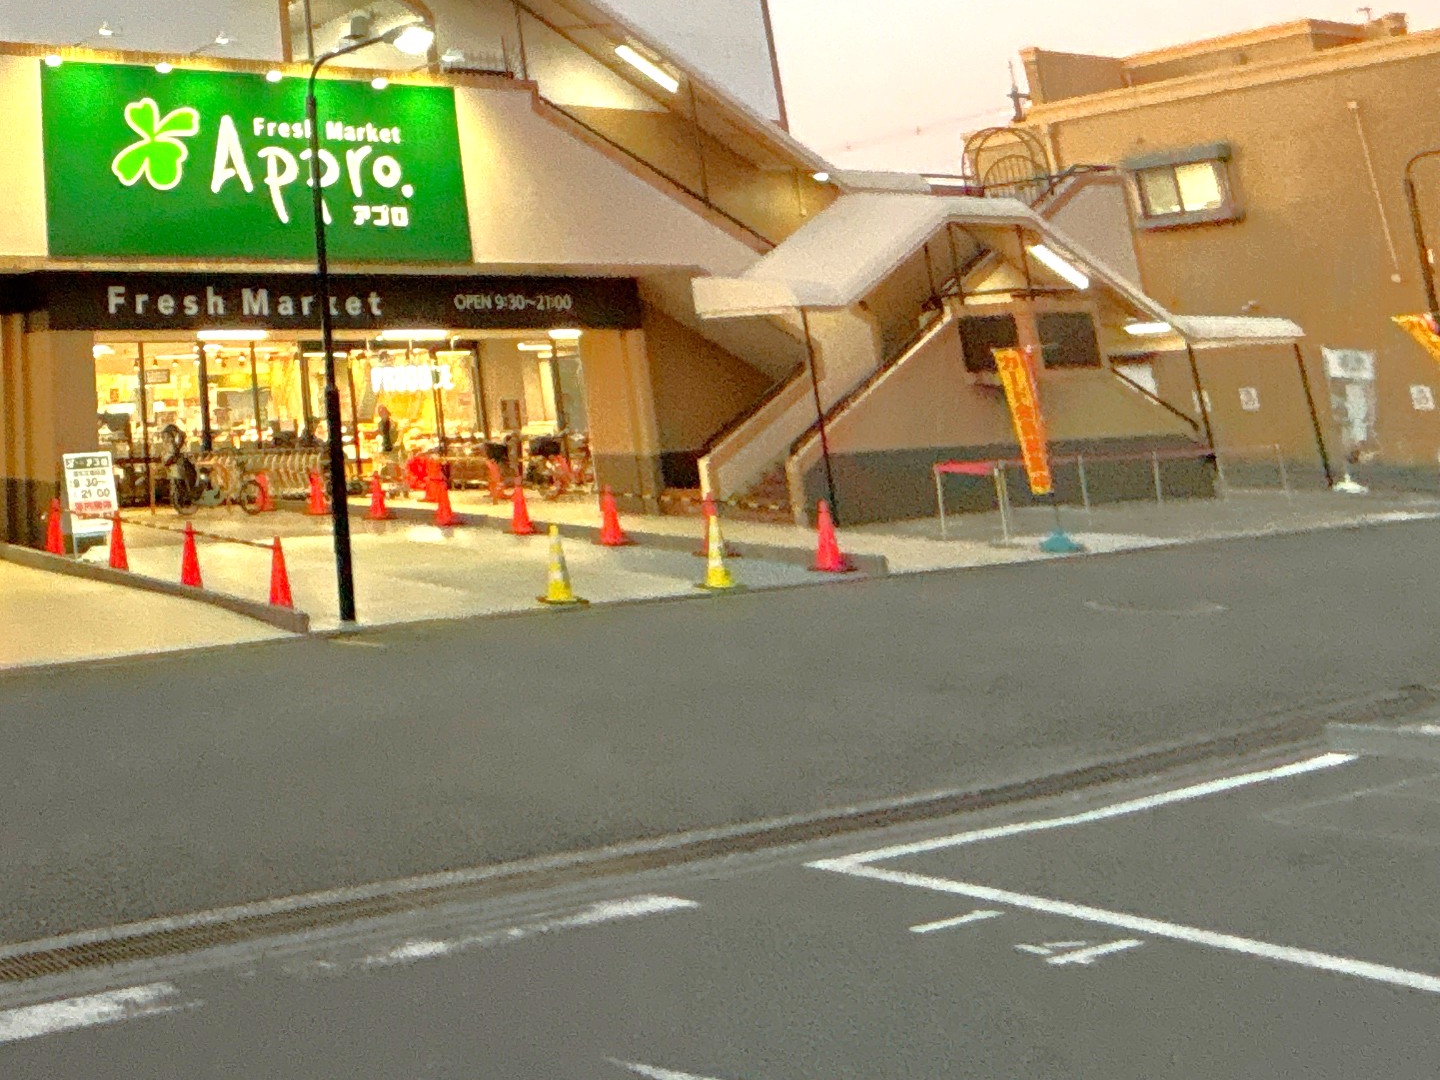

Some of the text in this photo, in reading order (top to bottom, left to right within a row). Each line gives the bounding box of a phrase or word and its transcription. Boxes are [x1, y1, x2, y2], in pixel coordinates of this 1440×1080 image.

[325, 120, 401, 144] Market
[107, 285, 225, 315] Fresh
[453, 293, 492, 311] OPEN
